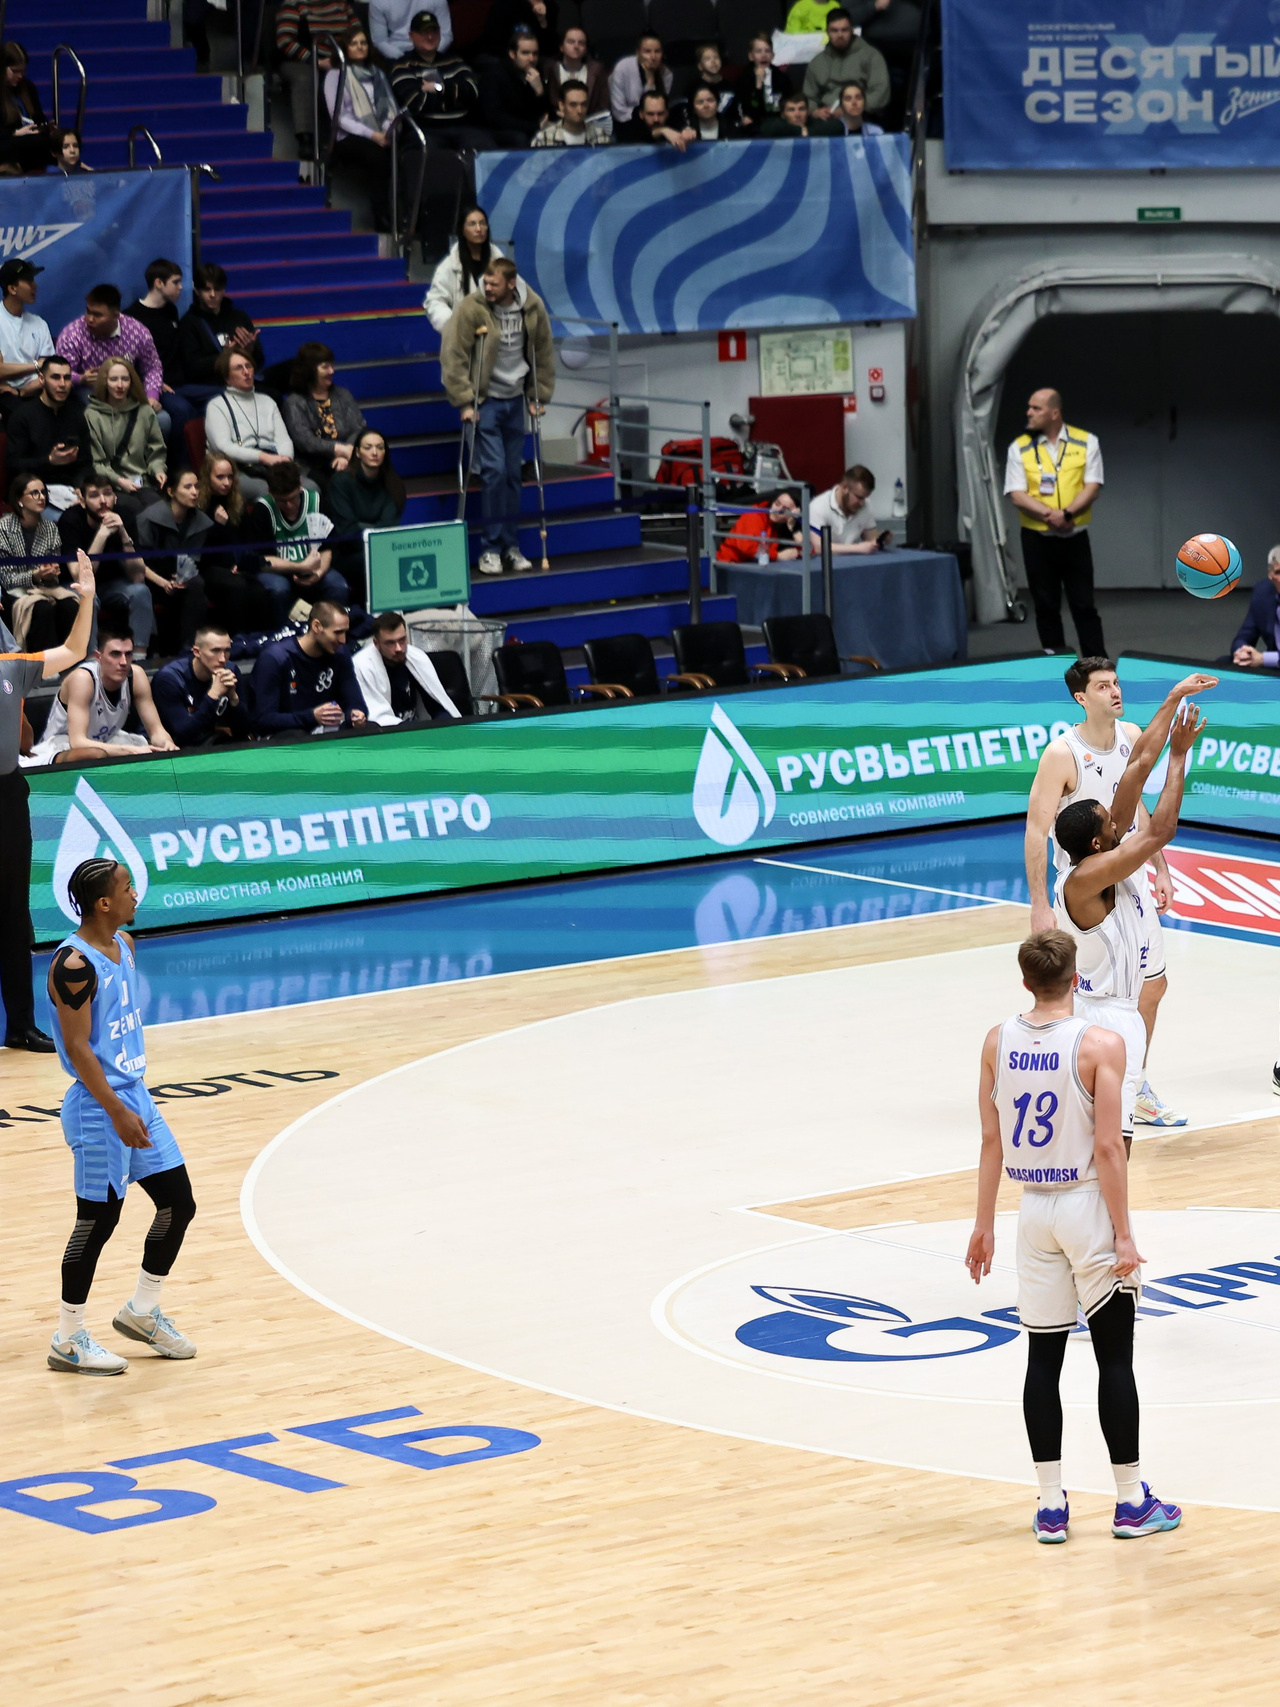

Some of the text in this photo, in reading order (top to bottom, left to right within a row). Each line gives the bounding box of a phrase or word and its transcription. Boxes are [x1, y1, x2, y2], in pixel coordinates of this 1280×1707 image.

[1024, 89, 1213, 123] СЕЗОН
[789, 790, 965, 827] совместная компания
[1191, 782, 1257, 801] совместная
[150, 794, 492, 871] РУСВЬЕТПЕТРО
[163, 867, 364, 908] совместная компания
[1009, 1051, 1060, 1071] SONKO
[1012, 1091, 1058, 1148] 13
[0, 1406, 541, 1534] ВТБ
